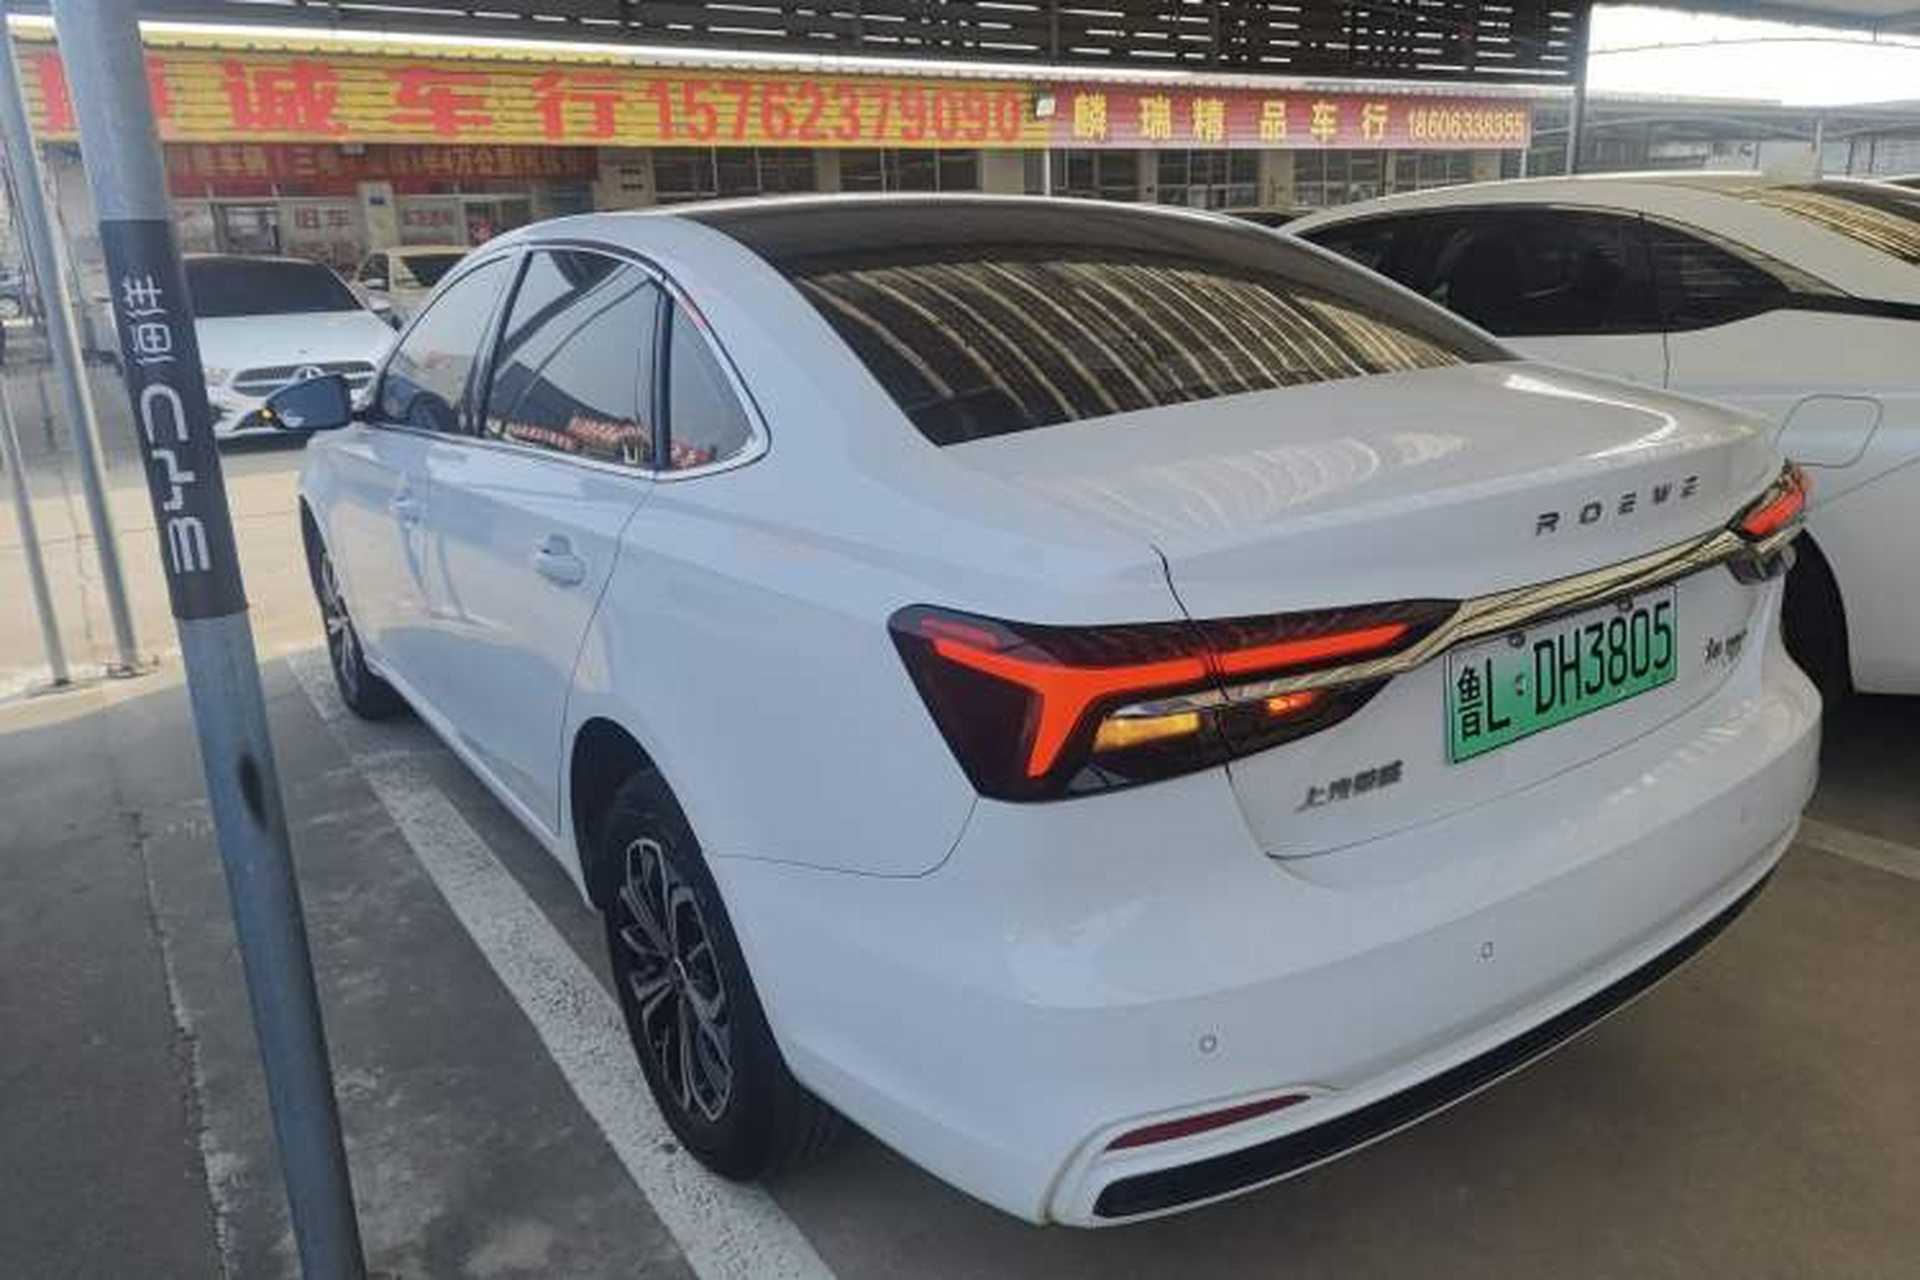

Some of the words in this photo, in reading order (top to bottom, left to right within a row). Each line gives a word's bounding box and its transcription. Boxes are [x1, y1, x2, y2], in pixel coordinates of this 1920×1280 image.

[649, 80, 1021, 142] 15762379090
[123, 275, 177, 366] 海洋
[141, 383, 211, 574] BYD
[1535, 475, 1699, 536] ROEWE
